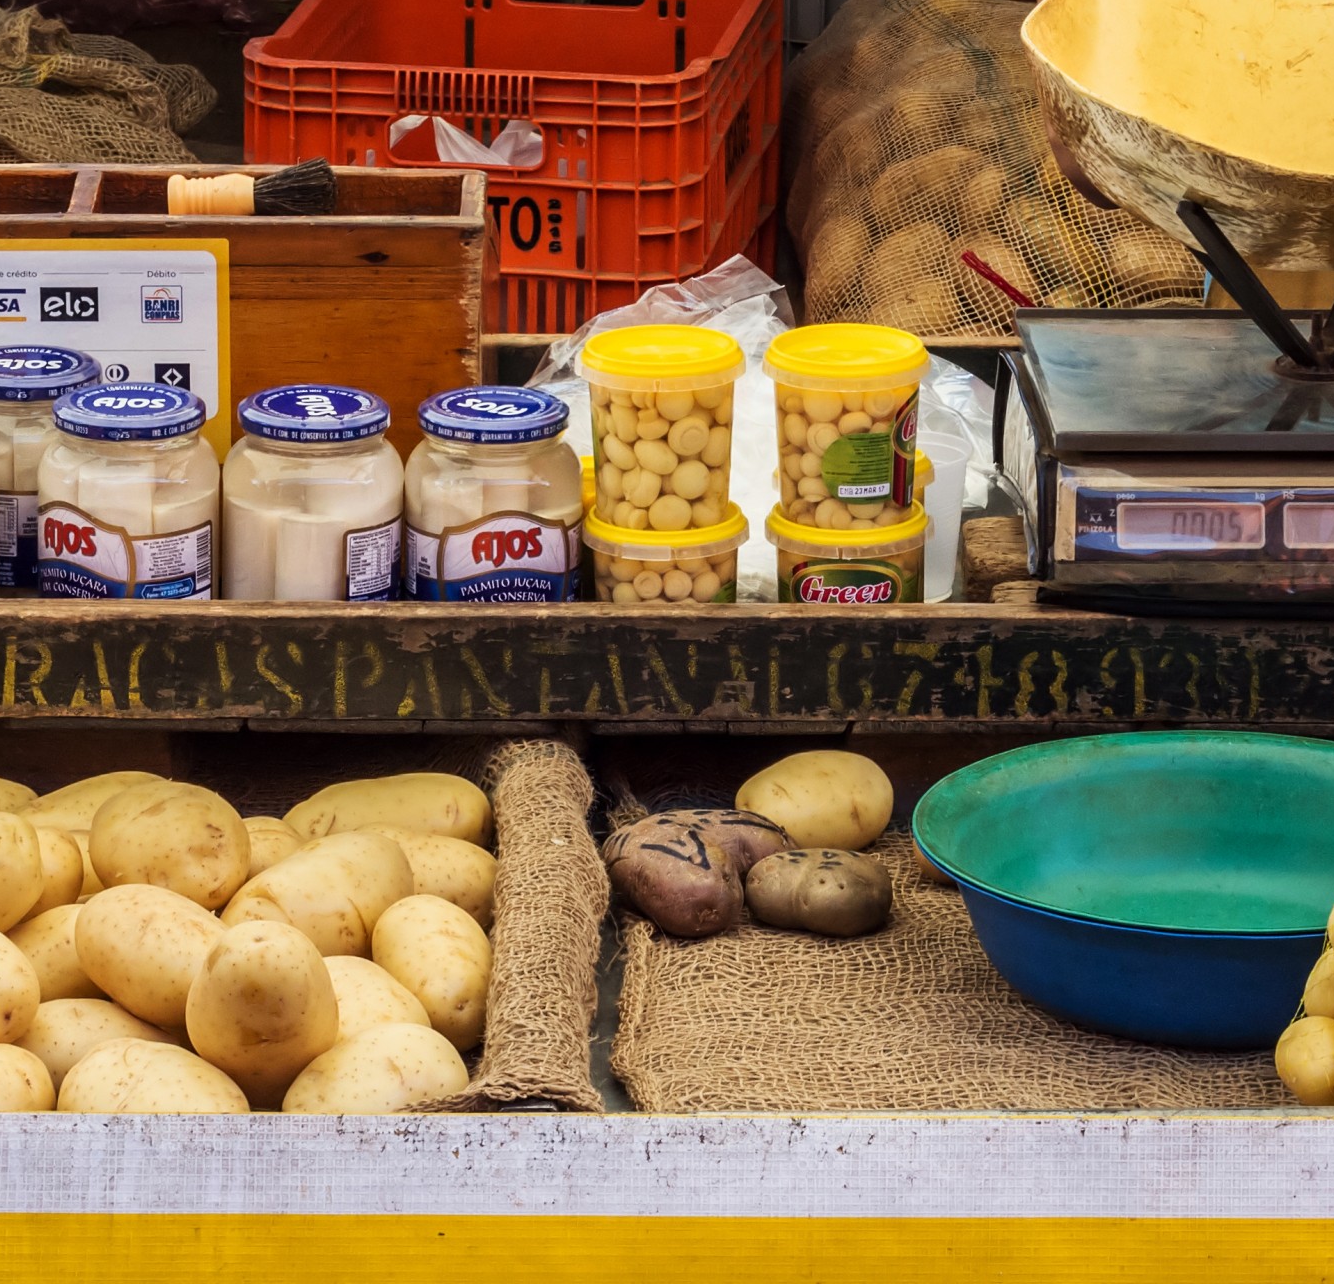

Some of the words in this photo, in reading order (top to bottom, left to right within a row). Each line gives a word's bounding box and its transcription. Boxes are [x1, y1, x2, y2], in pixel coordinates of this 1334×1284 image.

[6, 270, 38, 278] crédito
[147, 270, 177, 278] Débito
[144, 300, 179, 311] BANRI
[93, 397, 166, 409] AJOS
[456, 398, 528, 416] AJOS
[300, 430, 328, 440] CONSERVAS
[44, 517, 97, 557] AJOS
[472, 527, 543, 568] AJOS
[53, 581, 100, 599] CONSERV
[69, 571, 107, 595] JUÇARA
[460, 578, 510, 596] PALMITO
[513, 577, 552, 592] JUÇARA
[800, 575, 892, 603] Green
[490, 591, 546, 603] CONSERVA
